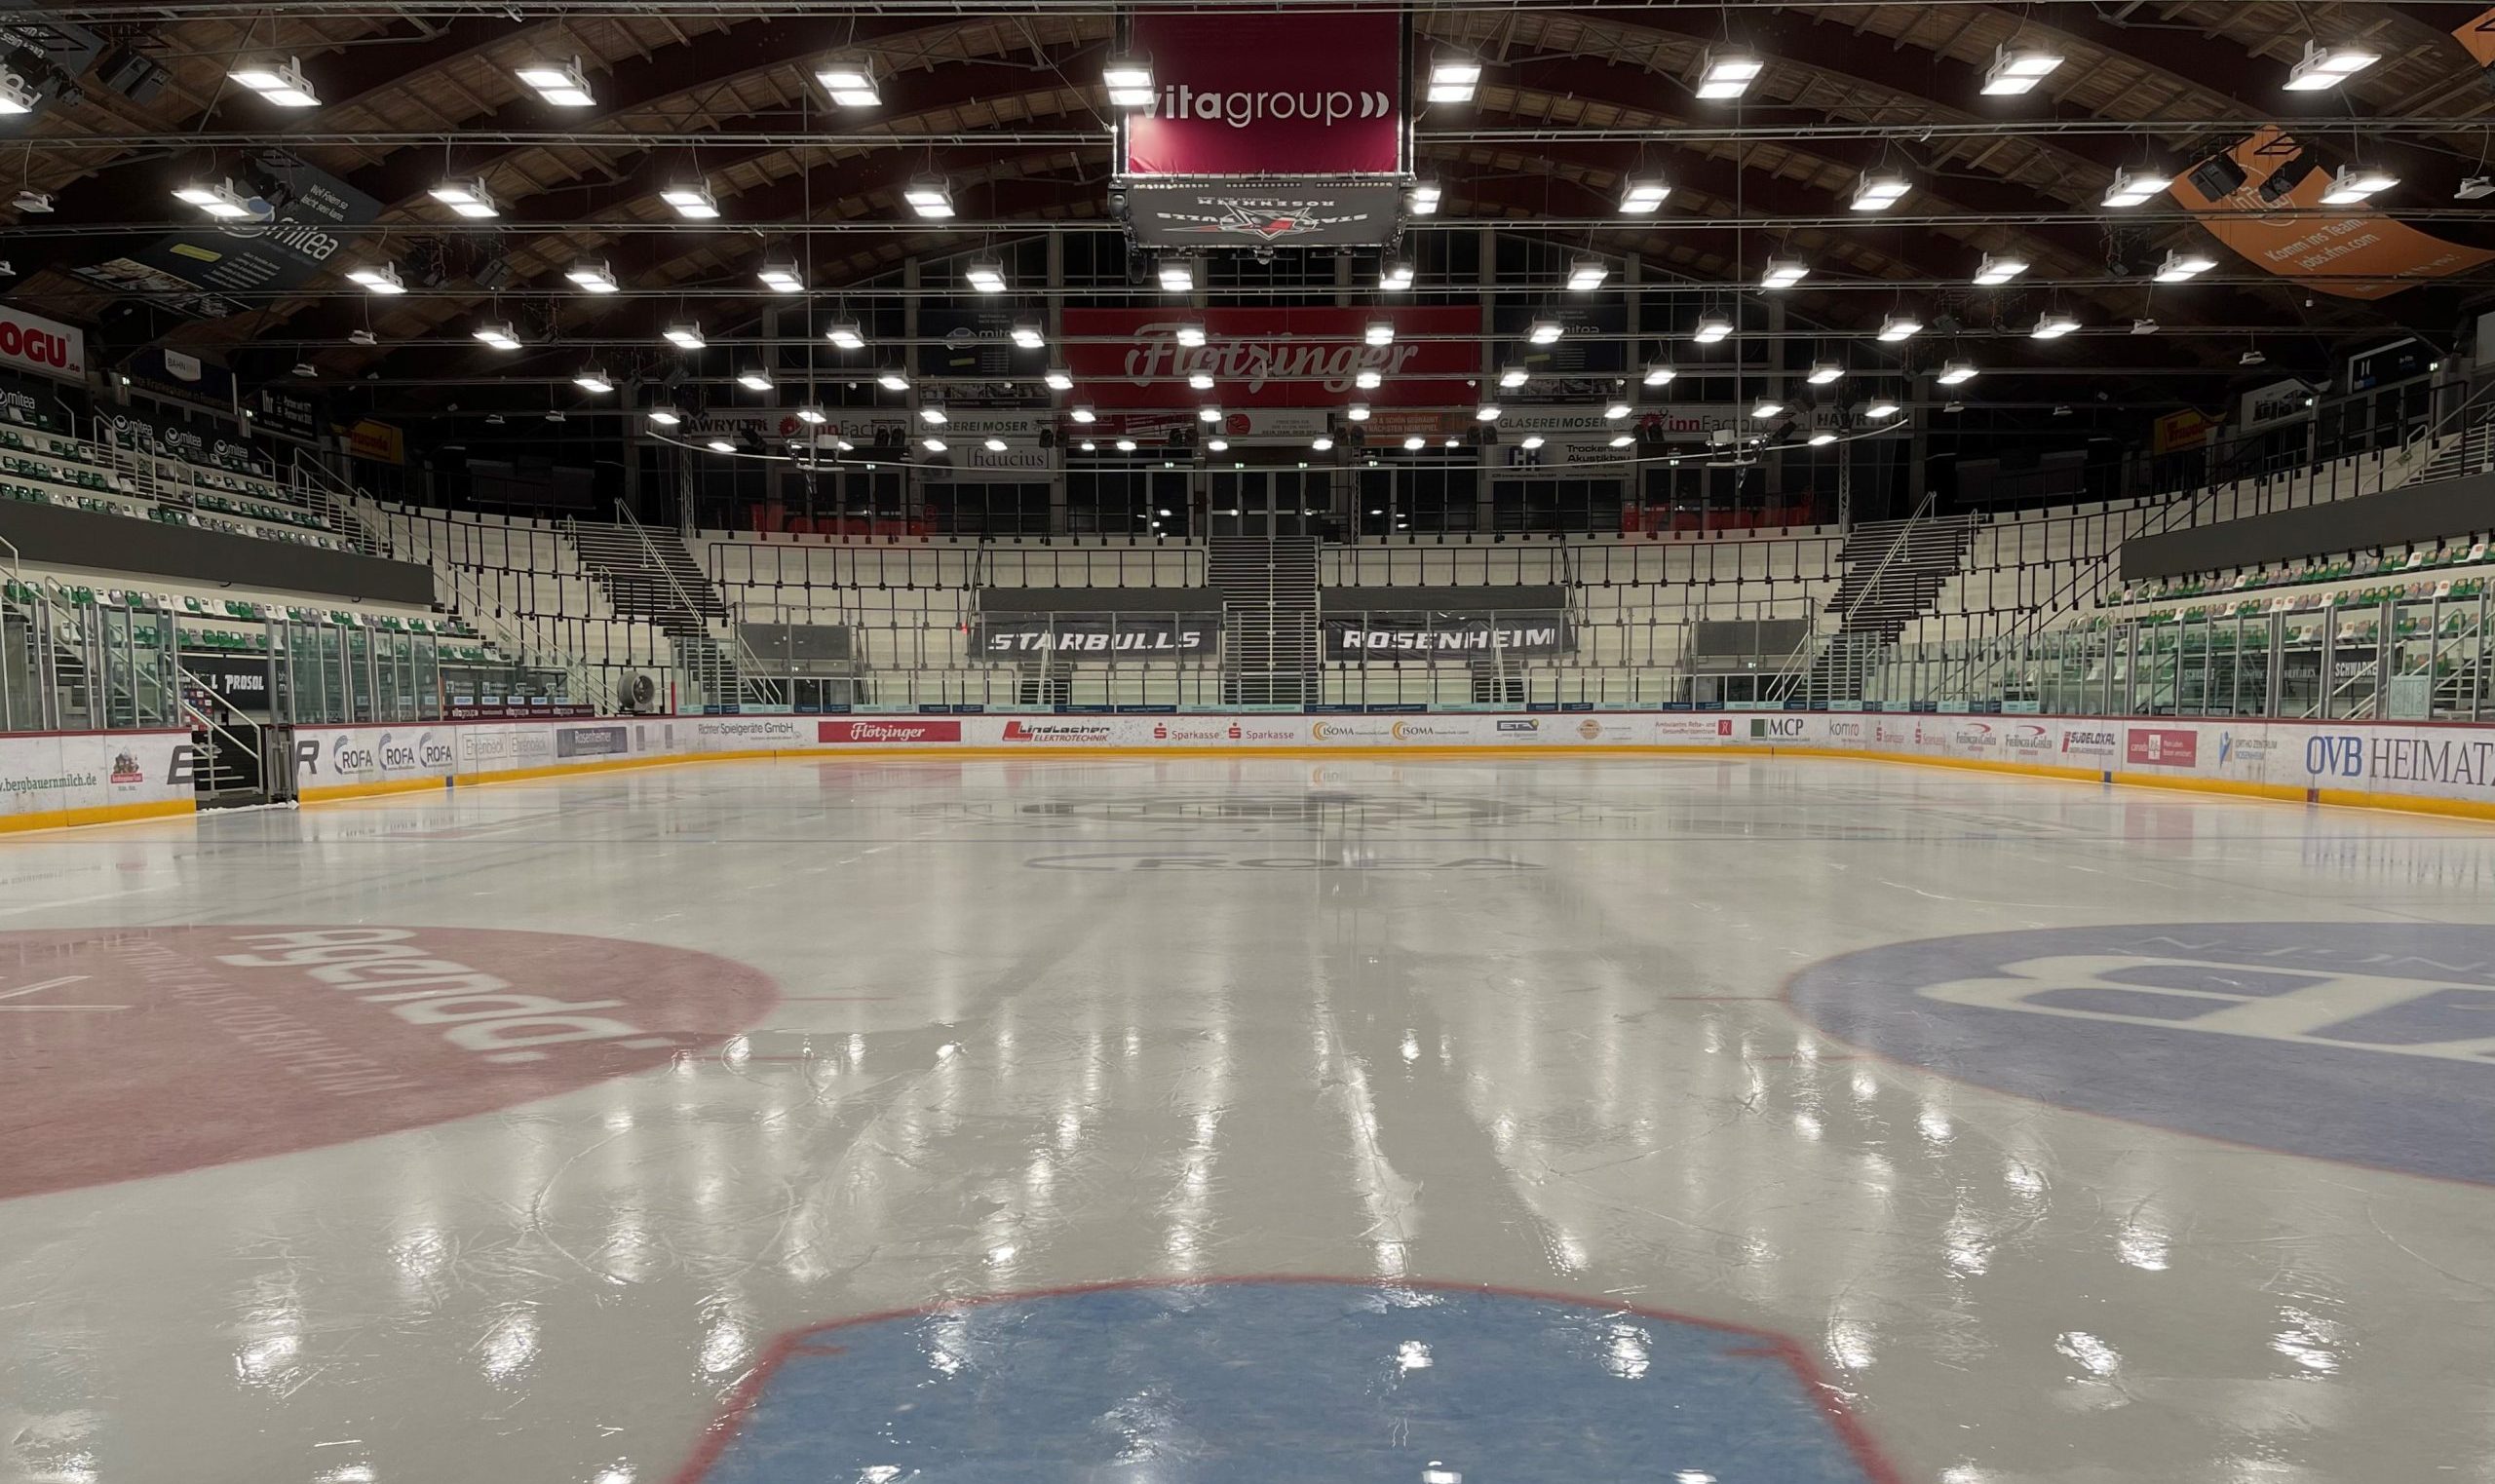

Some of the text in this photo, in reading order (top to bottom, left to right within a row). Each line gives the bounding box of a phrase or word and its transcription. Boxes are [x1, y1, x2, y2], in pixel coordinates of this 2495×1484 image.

[1142, 83, 1354, 129] vitagroup
[2266, 241, 2302, 263] Komm
[2303, 233, 2329, 247] ins
[7, 391, 36, 409] mitea
[130, 419, 153, 437] mitea
[982, 421, 1028, 432] MOSER
[1499, 417, 1608, 429] GLASEREI MOSER
[179, 431, 203, 447] mitea
[227, 442, 249, 459] mitea
[987, 631, 1202, 651] STARBULLS
[1342, 628, 1556, 650] ROSENHEIM
[224, 674, 265, 695] PROSOL
[698, 722, 794, 737] Richter Spielgeräte GmbH
[851, 722, 926, 742] Flötzinger
[1171, 730, 1220, 741] Sparkasse
[1246, 730, 1294, 741] Sparkasse
[1323, 727, 1355, 736] ISOMA
[1402, 726, 1434, 735] ISOMA
[1768, 718, 1804, 736] MCP
[1829, 719, 1860, 737] komro
[2070, 731, 2116, 745] SÜDELOXAL
[342, 749, 374, 769] ROFA
[386, 747, 415, 765] ROFA
[426, 744, 453, 762] ROFA
[2305, 736, 2363, 777] OVB
[2369, 738, 2495, 786] HEIMAT
[189, 1005, 421, 1096] ROSENHEIM
